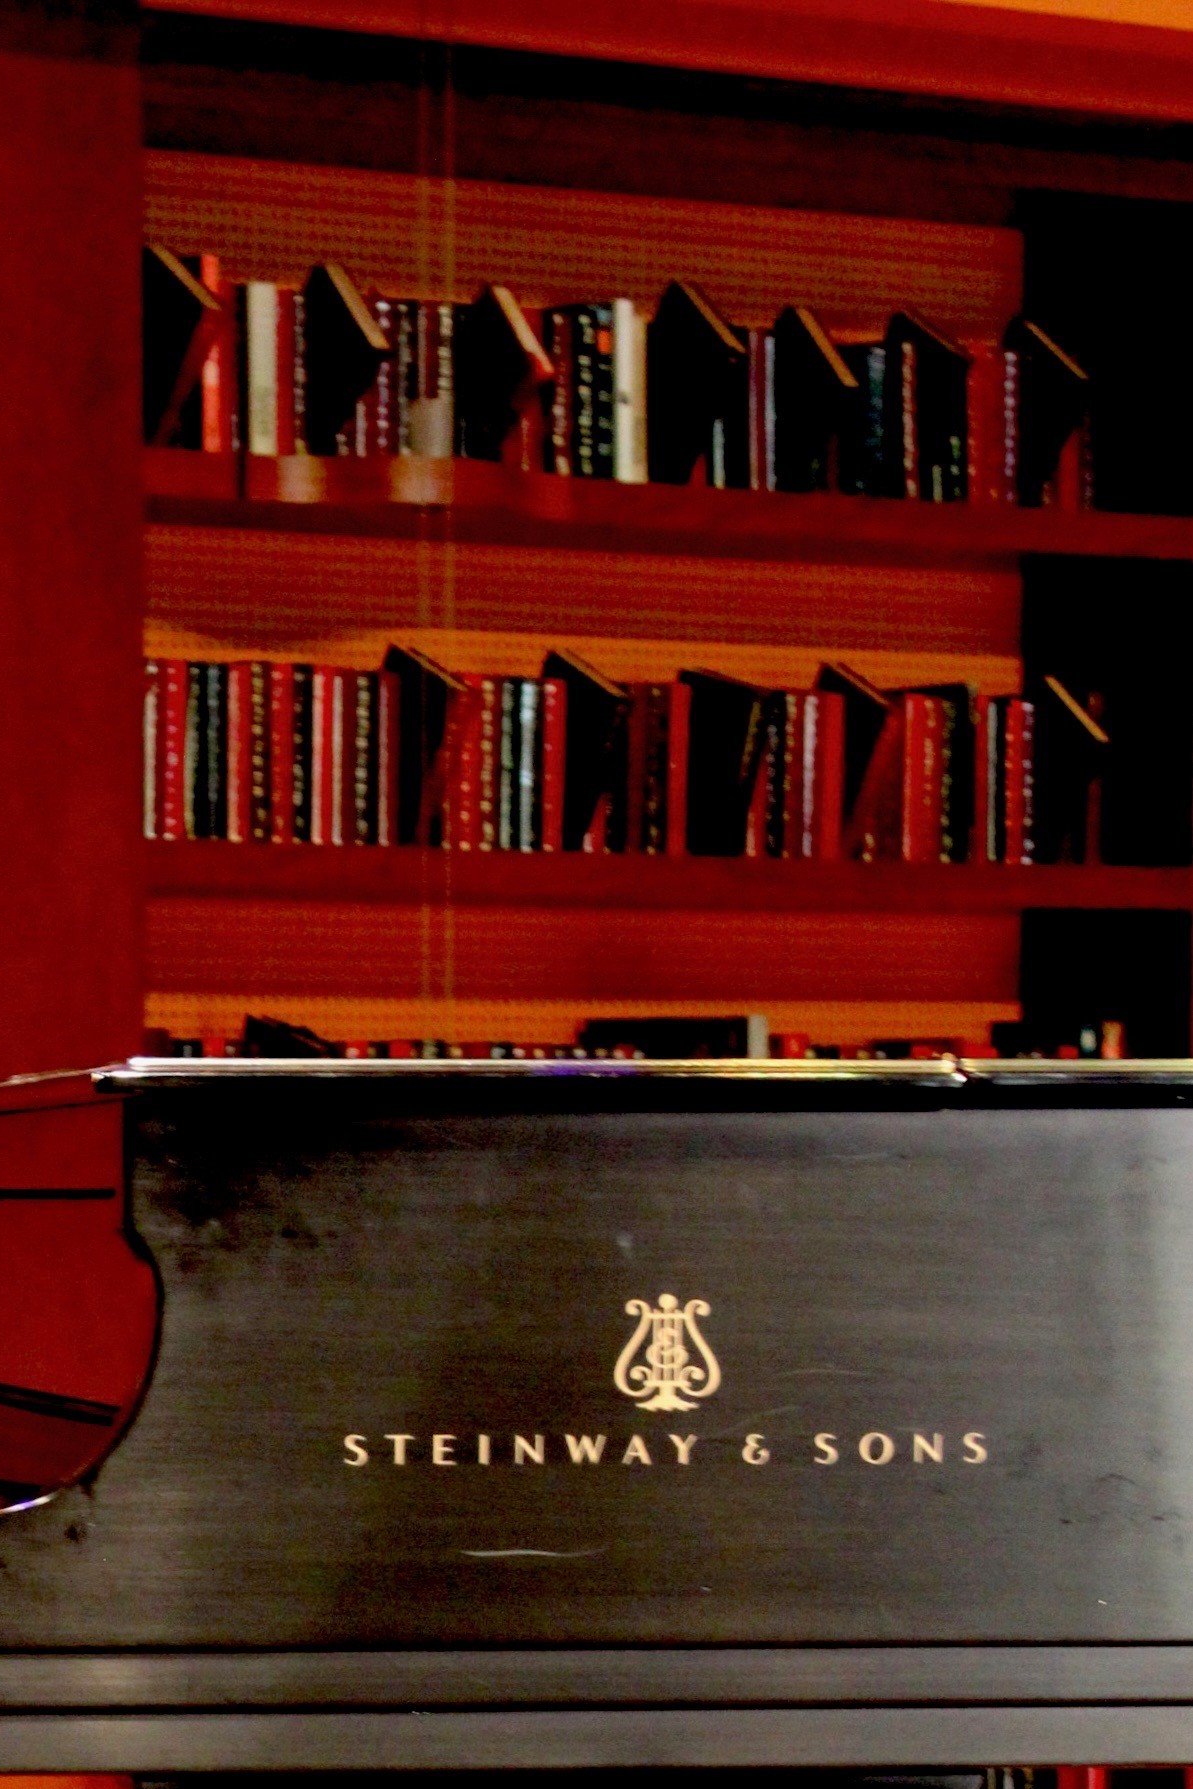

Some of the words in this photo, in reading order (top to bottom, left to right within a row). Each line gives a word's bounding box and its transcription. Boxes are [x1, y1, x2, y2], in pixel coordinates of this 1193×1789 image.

[342, 1431, 700, 1467] STEINWAY
[739, 1431, 772, 1467] &
[812, 1430, 990, 1467] SONS
